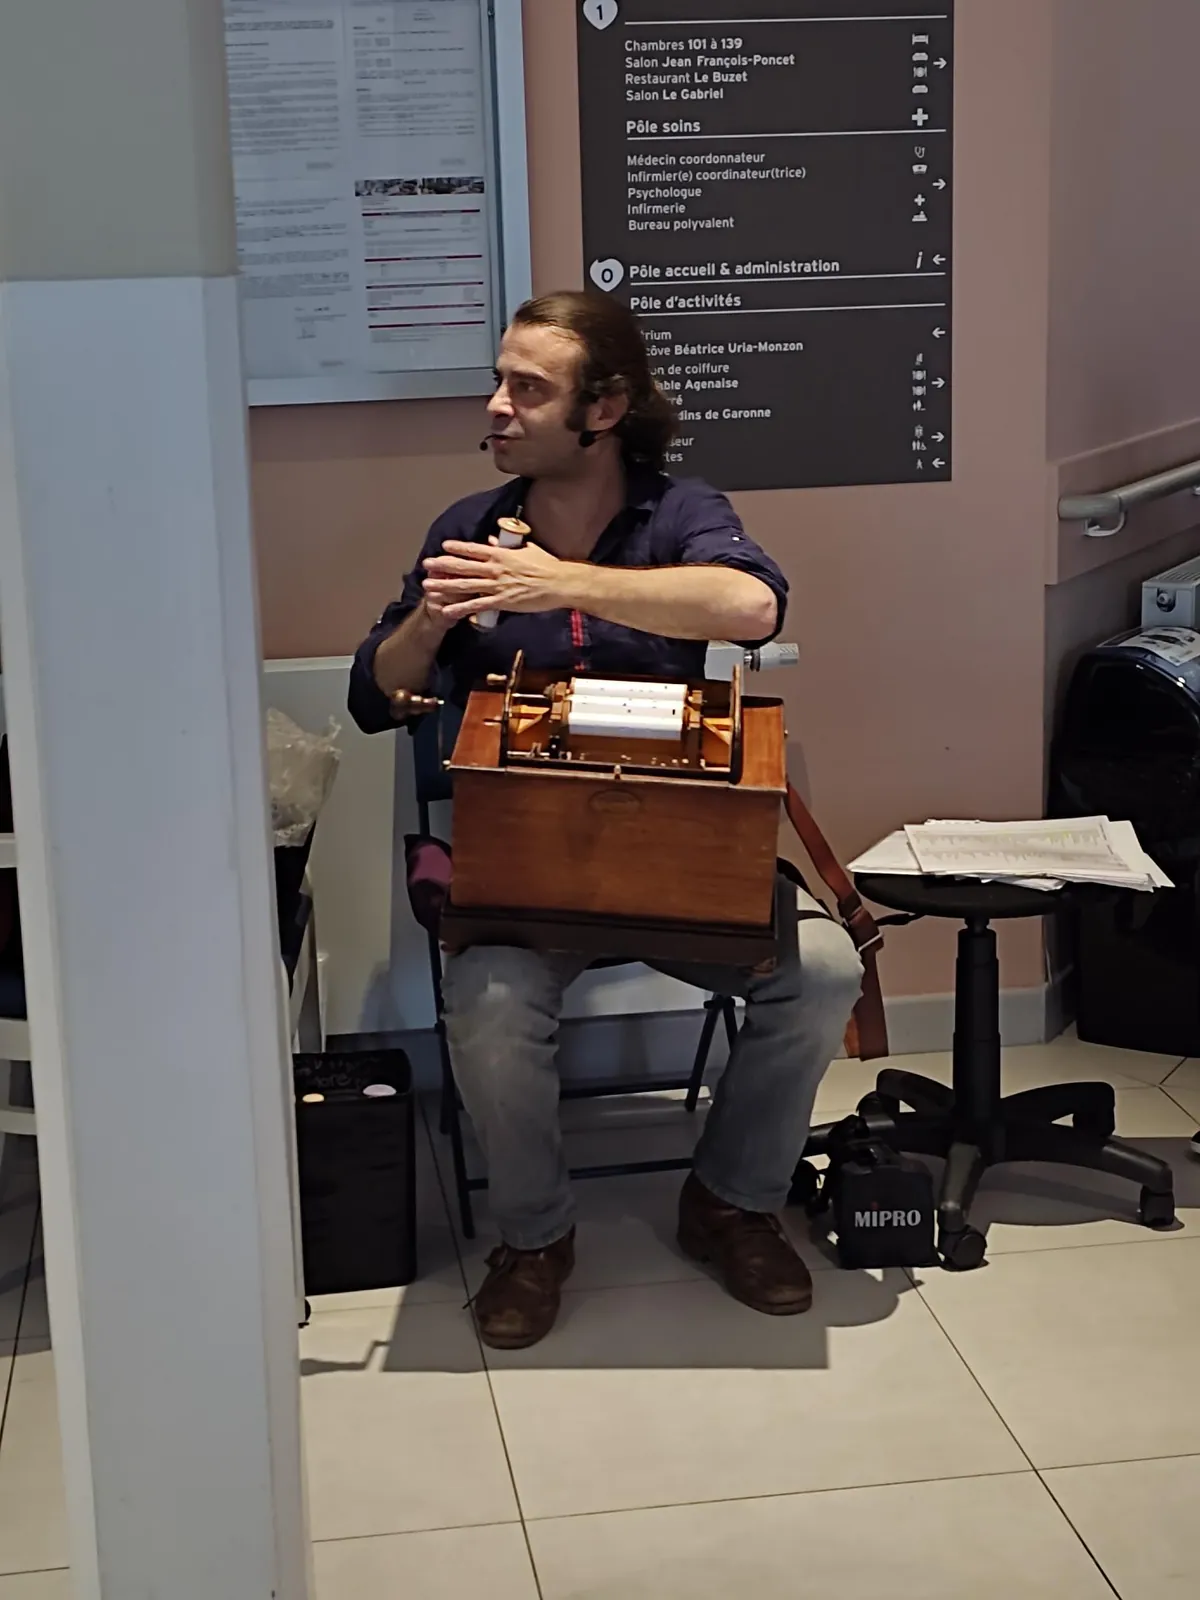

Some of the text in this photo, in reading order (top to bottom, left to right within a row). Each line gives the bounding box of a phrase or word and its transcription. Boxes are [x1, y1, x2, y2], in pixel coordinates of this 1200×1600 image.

[596, 4, 605, 20] 1
[624, 37, 743, 52] Chambres 101 à 139
[624, 53, 795, 69] Salon Jean François-Poncet
[624, 70, 748, 85] Restaurant Le Buzet
[625, 87, 724, 102] Salon Le Gabriel
[626, 118, 701, 134] Pôle soins
[627, 152, 766, 166] Médecin coordonnateur
[627, 166, 806, 183] Infirmier(e) coordinateur(trice)
[627, 186, 702, 201] Psychologue
[627, 202, 686, 215] Infirmerie
[628, 216, 735, 232] Bureau polyvalent
[629, 259, 840, 279] Pôle accueil & administration
[630, 292, 742, 310] Pôle d'activités
[639, 329, 672, 341] rium
[674, 343, 725, 356] Béatrice
[728, 341, 804, 354] Uria-Monzon
[667, 364, 682, 375] de
[684, 362, 730, 375] coiffure
[684, 377, 739, 392] Agenaise
[704, 409, 719, 420] de
[722, 408, 772, 420] Garonne
[854, 1209, 922, 1228] MIPRO
